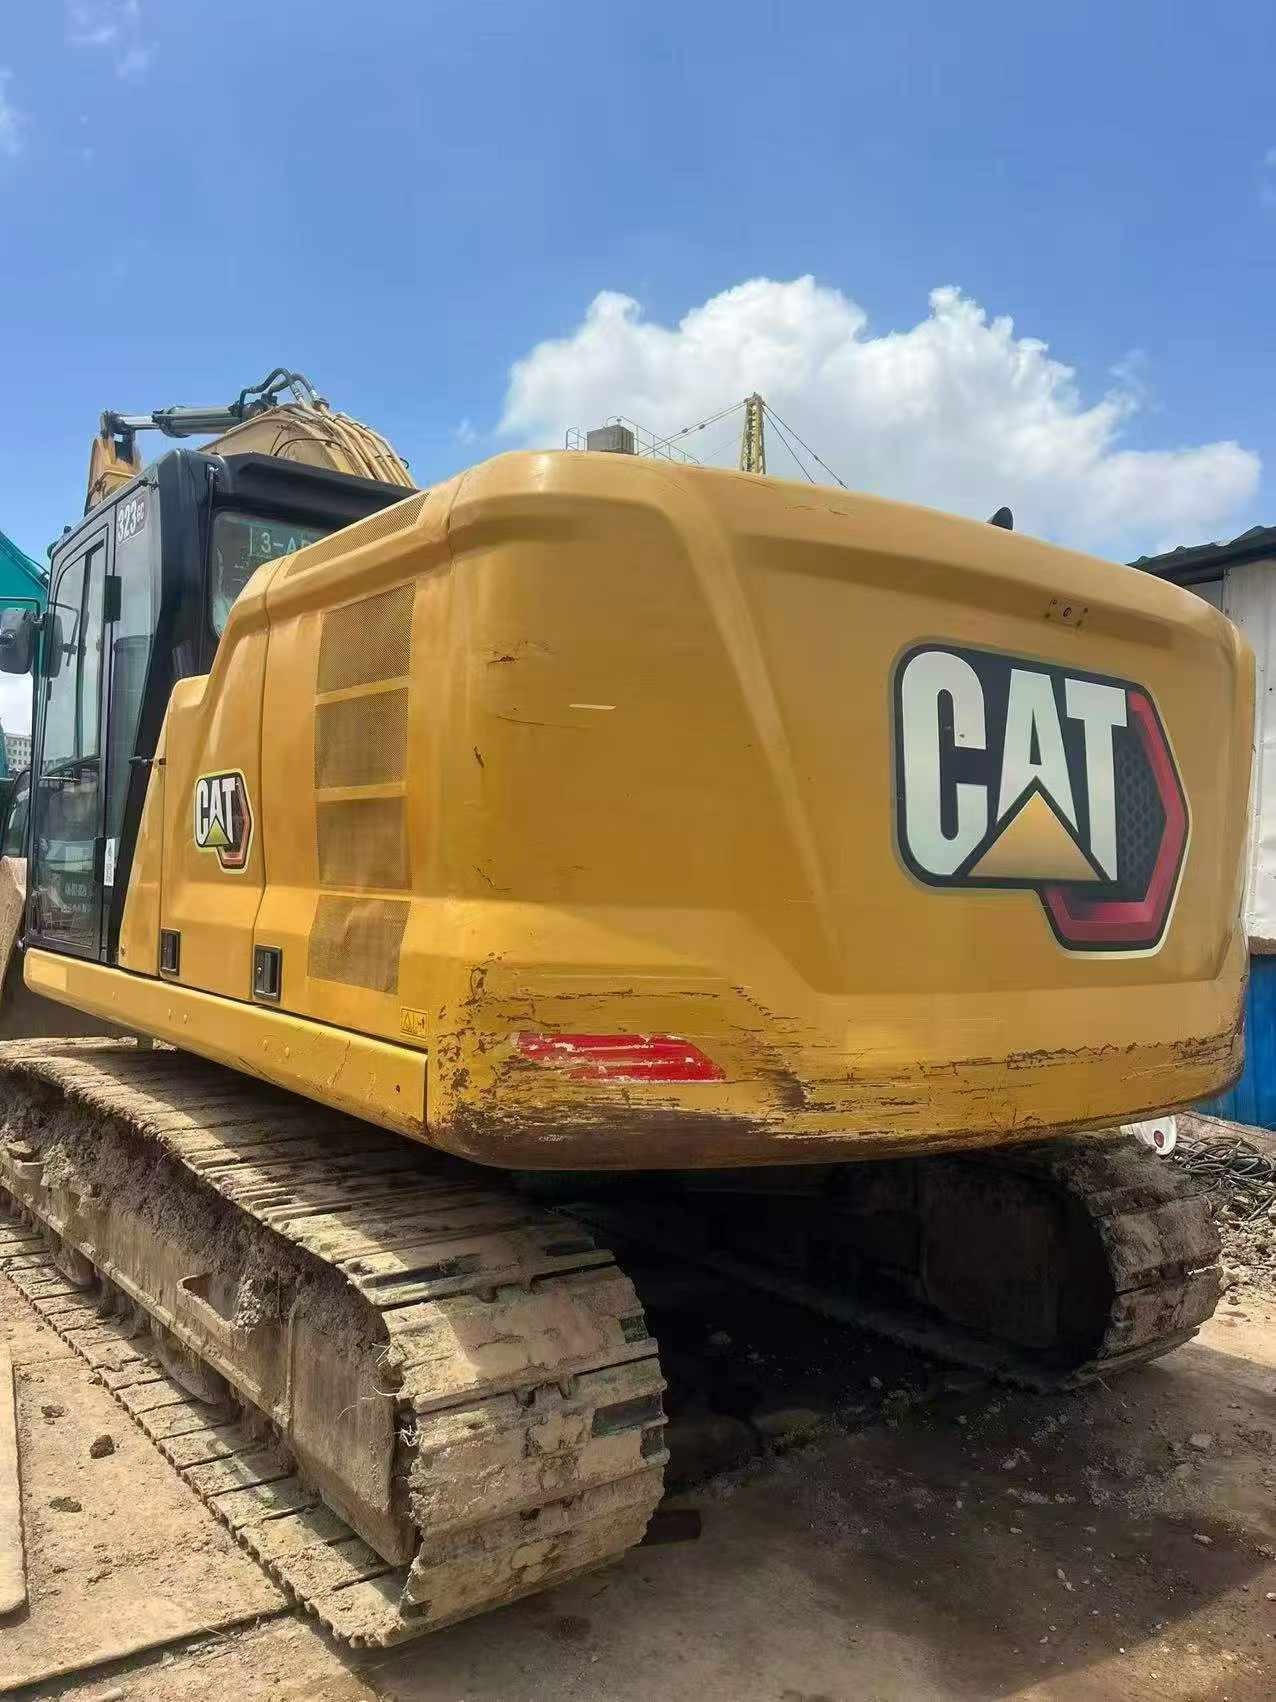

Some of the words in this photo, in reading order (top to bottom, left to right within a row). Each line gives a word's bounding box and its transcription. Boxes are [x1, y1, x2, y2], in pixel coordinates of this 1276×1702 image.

[118, 499, 137, 542] 323
[902, 651, 1128, 881] CAT
[196, 777, 236, 846] CAT
